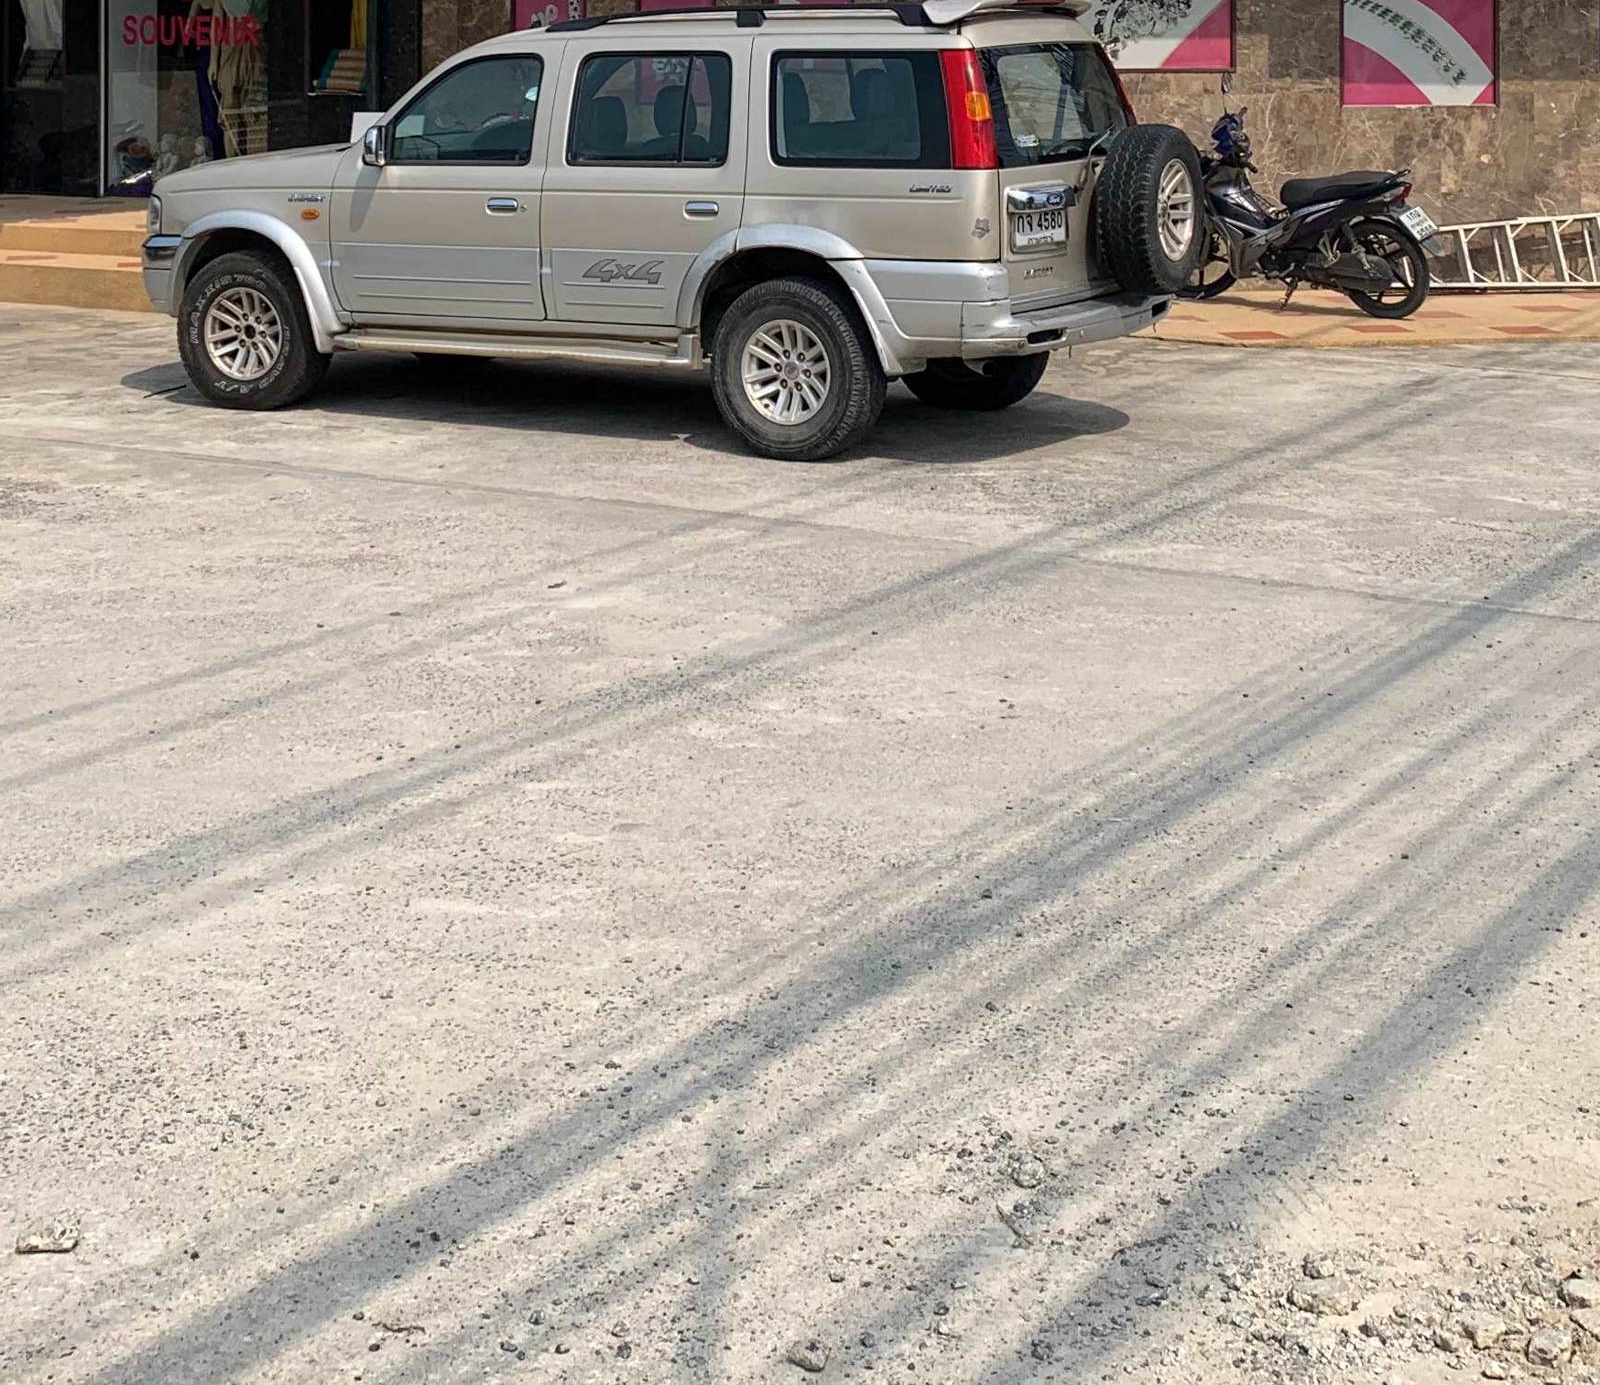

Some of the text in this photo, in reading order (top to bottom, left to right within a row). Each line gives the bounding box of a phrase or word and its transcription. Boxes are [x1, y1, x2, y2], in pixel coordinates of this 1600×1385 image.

[122, 15, 260, 47] SOUVENIR
[1037, 211, 1063, 232] 4580
[582, 258, 665, 285] 4x4
